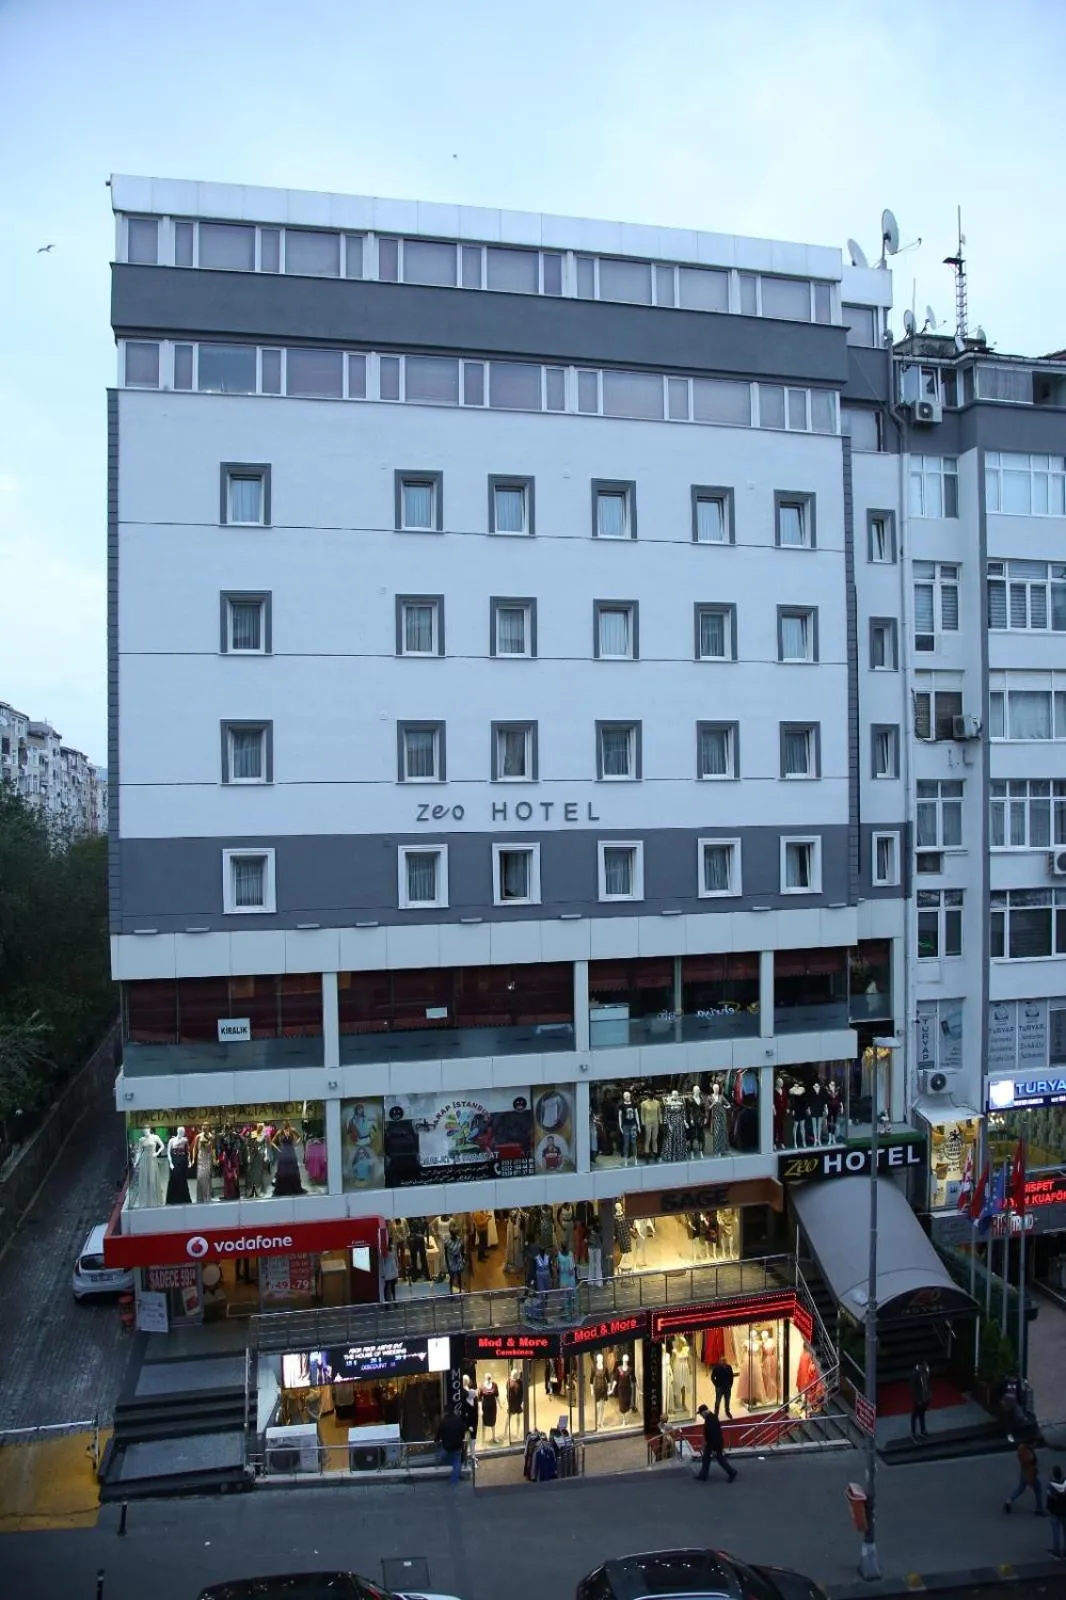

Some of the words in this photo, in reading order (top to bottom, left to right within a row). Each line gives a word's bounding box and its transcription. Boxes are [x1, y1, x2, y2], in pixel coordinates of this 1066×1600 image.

[492, 802, 600, 822] HOTEL
[824, 1145, 920, 1174] HOTEL
[213, 1236, 293, 1252] vodafone
[574, 1327, 597, 1342] Mod
[600, 1324, 608, 1337] &
[611, 1318, 637, 1334] More
[478, 1338, 501, 1347] Mod
[506, 1338, 514, 1347] &
[519, 1338, 549, 1348] More
